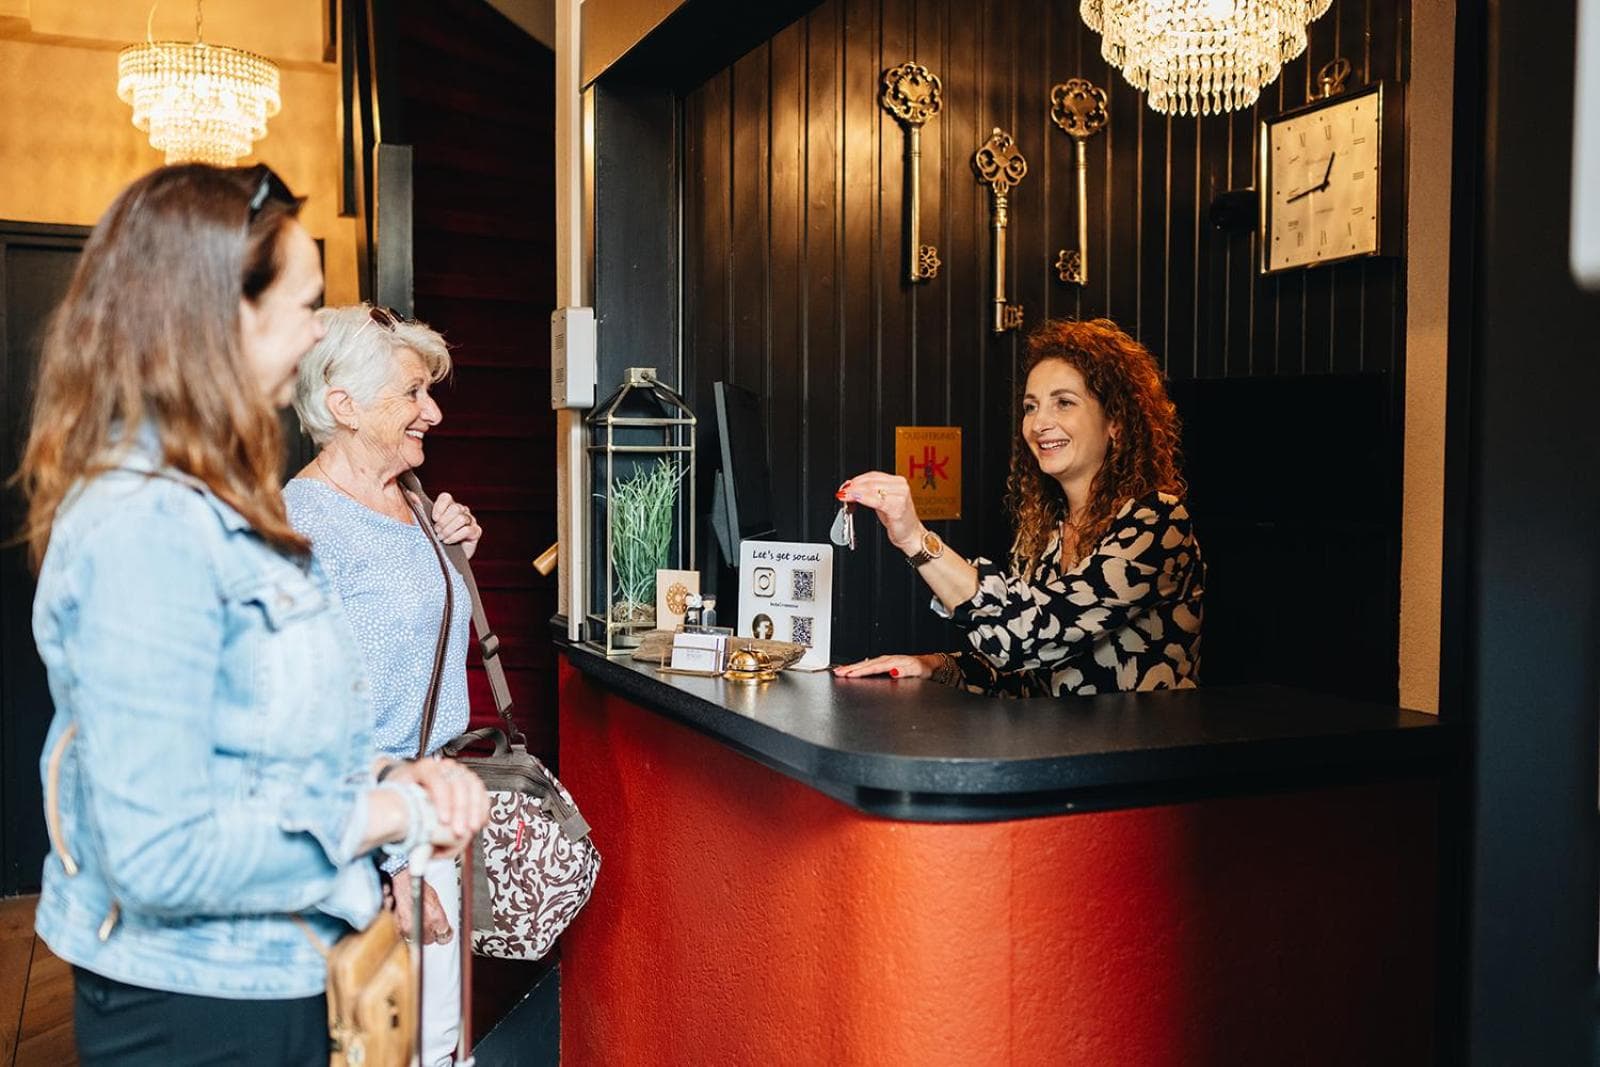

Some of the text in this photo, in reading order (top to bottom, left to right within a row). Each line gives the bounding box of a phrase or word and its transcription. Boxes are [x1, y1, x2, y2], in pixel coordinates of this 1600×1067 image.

[752, 550, 821, 562] Let's get social
